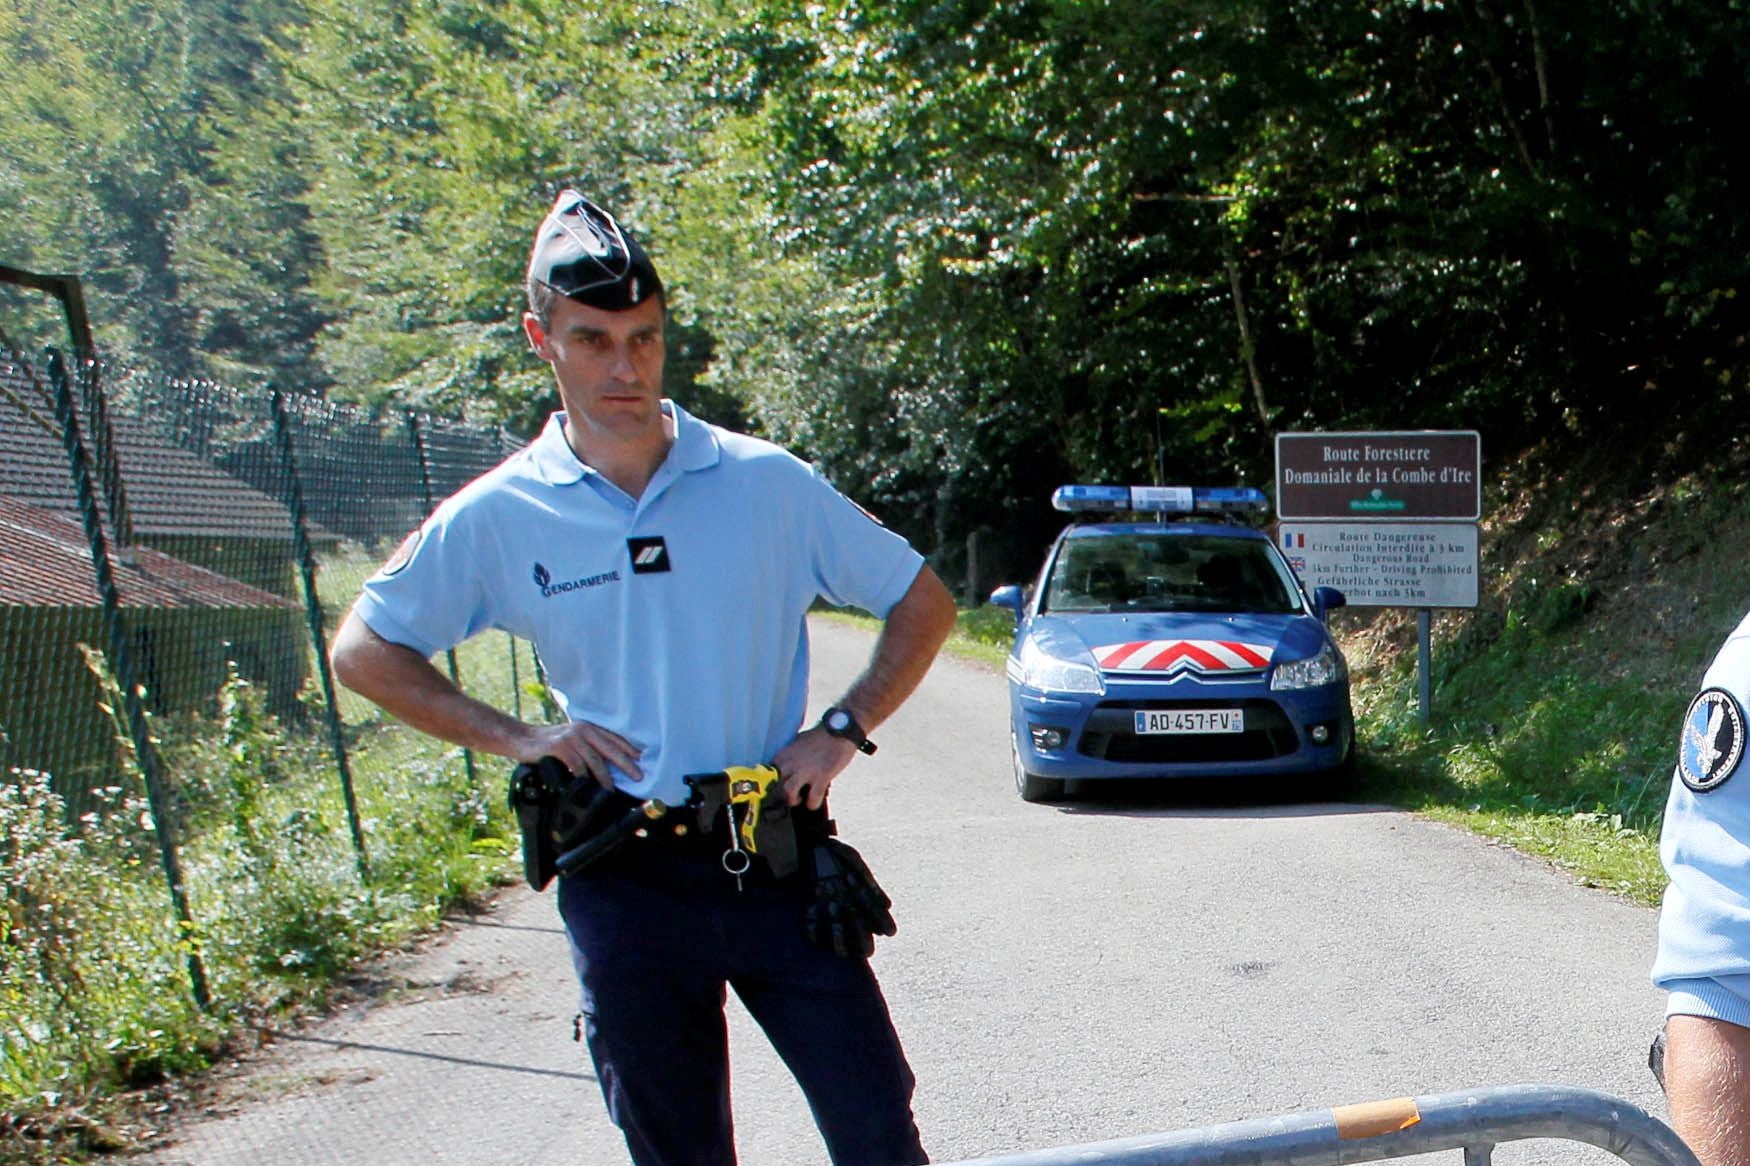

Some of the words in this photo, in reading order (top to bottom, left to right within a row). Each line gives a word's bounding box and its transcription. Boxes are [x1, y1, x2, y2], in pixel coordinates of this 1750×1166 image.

[1323, 446, 1359, 462] Route
[1285, 469, 1351, 484] Domaniale
[1356, 468, 1371, 483] de
[1376, 468, 1388, 483] la
[1393, 468, 1435, 483] Combe
[1440, 468, 1471, 483] d'Ire
[1339, 533, 1368, 541] Route
[1374, 533, 1436, 544] Dangereuse
[1377, 544, 1425, 552] Interdite
[1449, 544, 1464, 552] km
[1353, 554, 1402, 564] Dangerous
[1407, 555, 1429, 563] Road
[1381, 565, 1417, 576] Driving
[1420, 565, 1472, 574] Prohibited
[541, 569, 621, 597] GENDARMERIE
[1384, 578, 1421, 586] Strasse
[1375, 589, 1400, 598] nach
[1150, 713, 1230, 731] AD-457-FV
